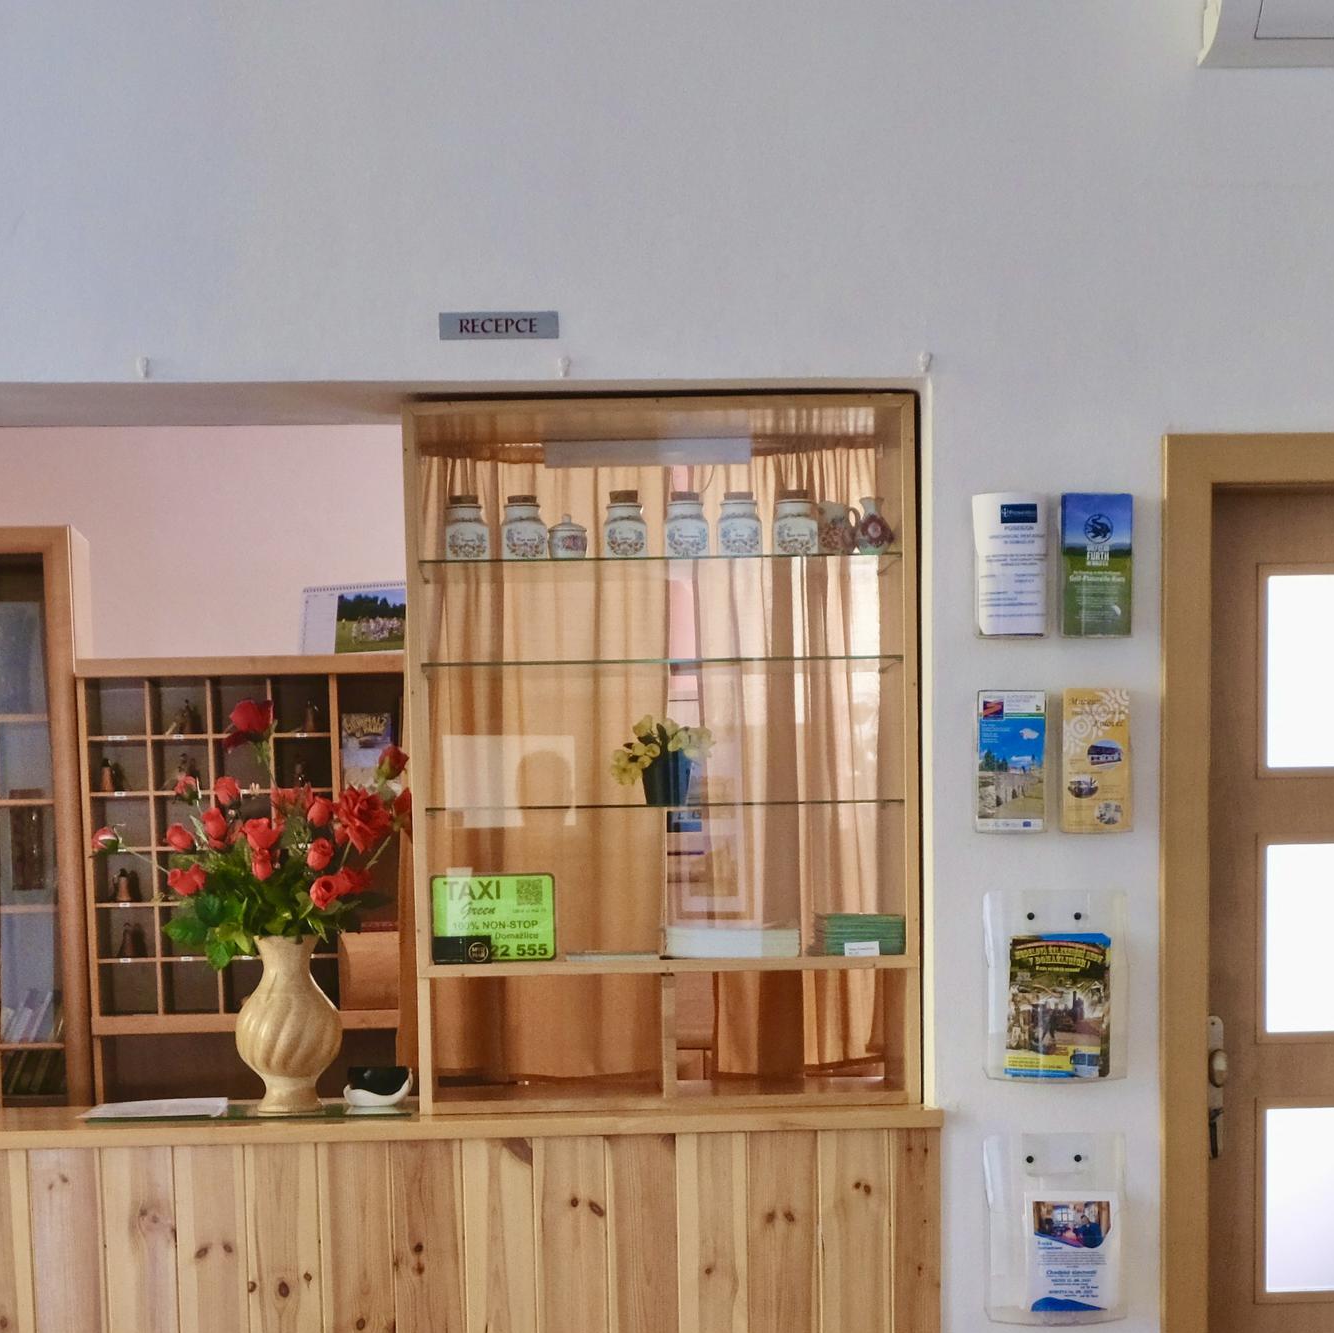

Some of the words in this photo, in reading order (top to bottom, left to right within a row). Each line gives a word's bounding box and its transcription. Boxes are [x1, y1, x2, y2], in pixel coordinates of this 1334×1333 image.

[459, 318, 539, 334] RECEPCE
[444, 880, 501, 901] TAXI
[460, 901, 496, 920] Green
[482, 920, 539, 931] NON-STOP
[516, 943, 548, 957] 555
